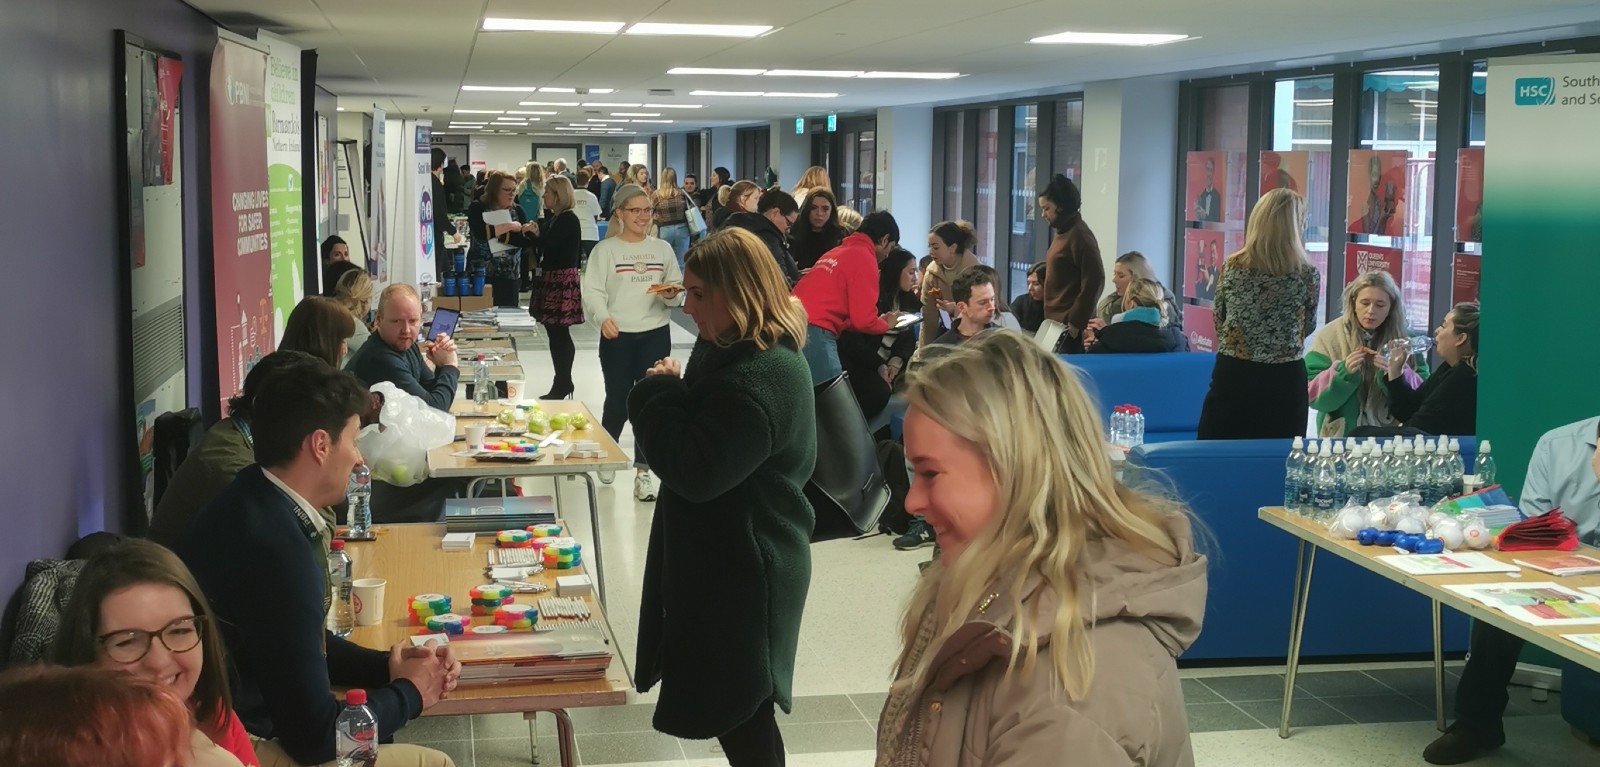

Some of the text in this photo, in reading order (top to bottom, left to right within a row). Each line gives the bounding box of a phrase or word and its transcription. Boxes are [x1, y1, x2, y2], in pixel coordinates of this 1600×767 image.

[271, 56, 299, 81] Believe in
[235, 81, 249, 104] PBNI
[271, 82, 296, 104] children
[1520, 86, 1547, 97] HSC
[1561, 93, 1586, 105] and
[272, 110, 300, 135] Barnardo's
[232, 190, 269, 211] CHANGING LIVES
[238, 212, 263, 233] FOR SAFER
[237, 234, 268, 256] COMMUNITIES
[293, 505, 311, 526] PBNI
